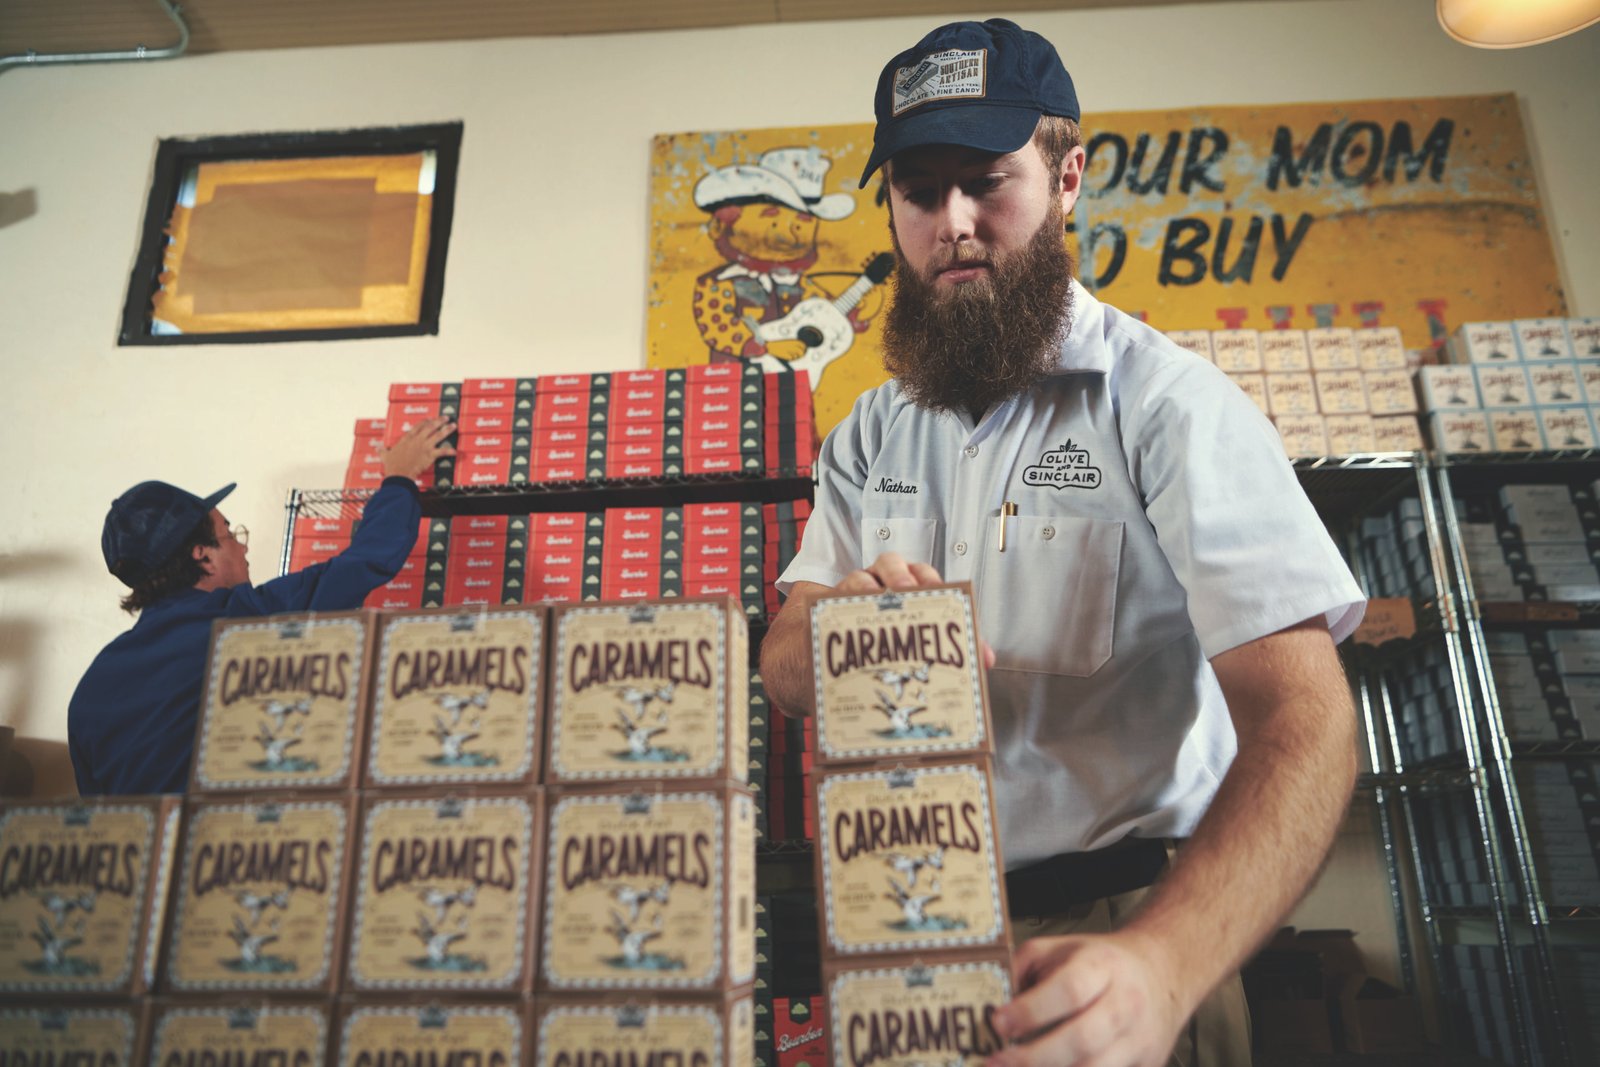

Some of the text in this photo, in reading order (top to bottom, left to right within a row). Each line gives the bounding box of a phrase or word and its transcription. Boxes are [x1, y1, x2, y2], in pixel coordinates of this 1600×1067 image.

[940, 59, 979, 75] SOUTHERN
[940, 68, 979, 84] ARTISAN
[895, 91, 928, 110] CHOCOLATE
[1265, 118, 1455, 192] MOM
[1065, 212, 1314, 289] O BUY
[874, 477, 919, 494] Nathan
[1028, 470, 1096, 483] SINCLAIR
[1046, 454, 1085, 464] OLIVE
[391, 645, 530, 699] CARAMELS
[568, 638, 714, 693] CARAMELS
[827, 621, 964, 678] CARAMELS
[221, 651, 351, 707] CARAMELS
[834, 801, 980, 862] CARAMELS
[0, 842, 139, 897] CARAMELS
[192, 839, 333, 897] CARAMELS
[373, 835, 518, 893] CARAMELS
[562, 831, 711, 892] CARAMELS
